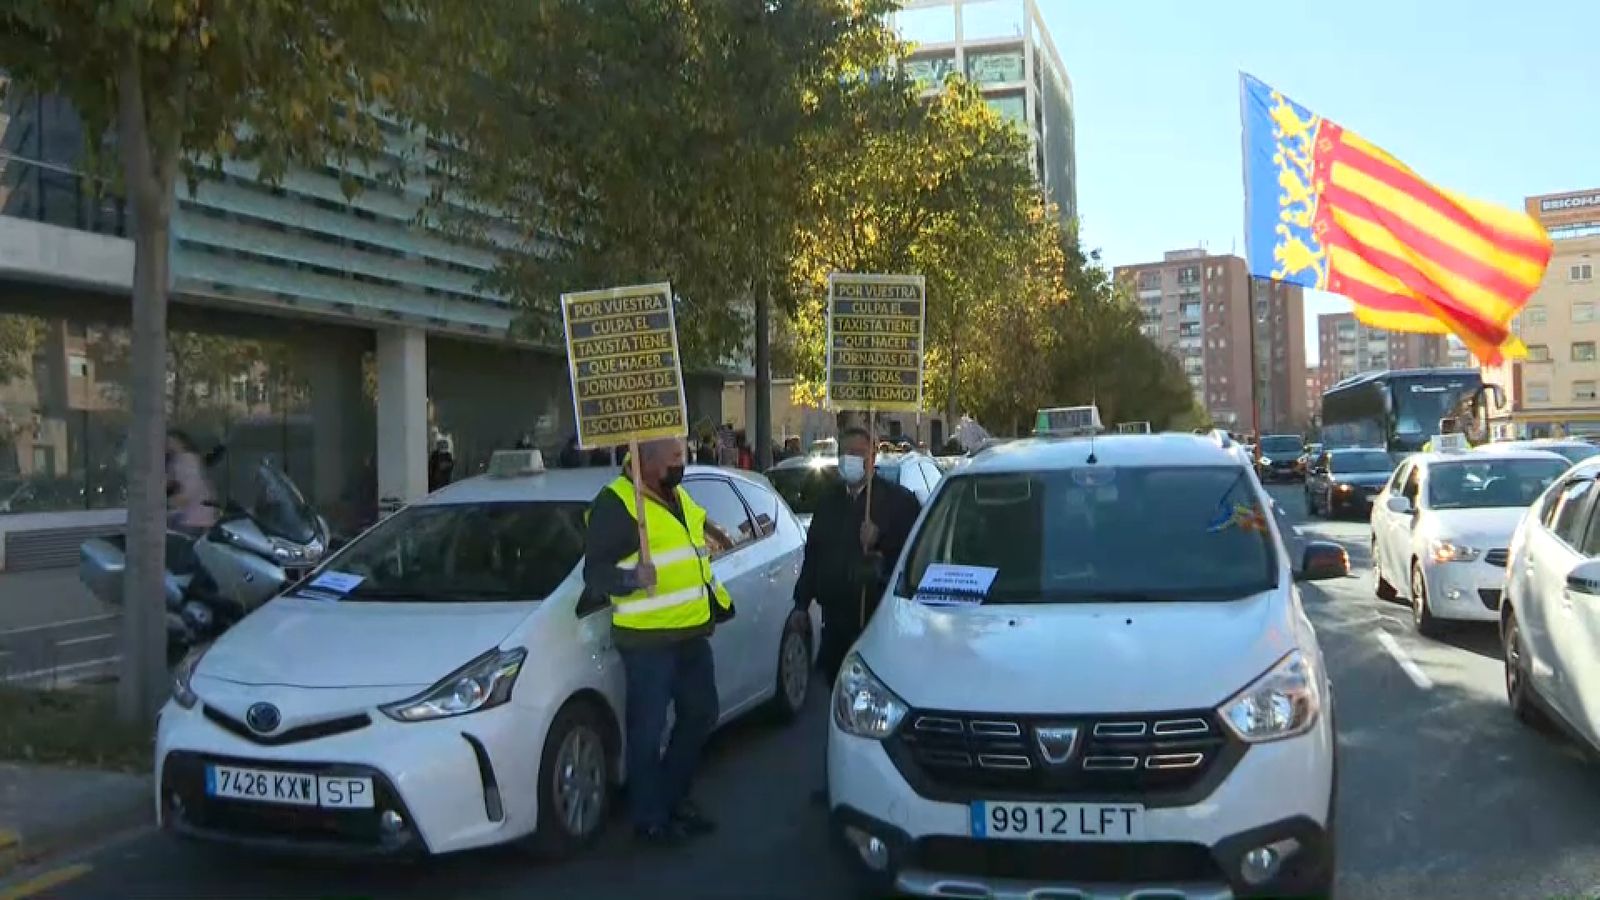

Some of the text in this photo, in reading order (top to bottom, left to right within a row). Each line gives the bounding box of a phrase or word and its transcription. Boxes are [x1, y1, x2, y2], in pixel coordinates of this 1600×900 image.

[840, 284, 917, 298] POR VUESTRA
[574, 295, 662, 317] POR VUESTRA
[852, 302, 903, 315] CULPA EL
[591, 315, 649, 335] CULPA EL
[839, 320, 917, 333] TAXISTA TIENE
[578, 334, 668, 357] TAXISTA TIENE
[844, 335, 908, 349] QUE HACER
[589, 354, 662, 375] QUE HACER
[837, 351, 914, 366] JORNADAS DE
[583, 372, 673, 396] JORNADAS DE
[599, 400, 613, 414] 16
[220, 771, 312, 800] 7426 KXW
[326, 779, 365, 805] SP
[991, 806, 1137, 835] 9912 LFT
